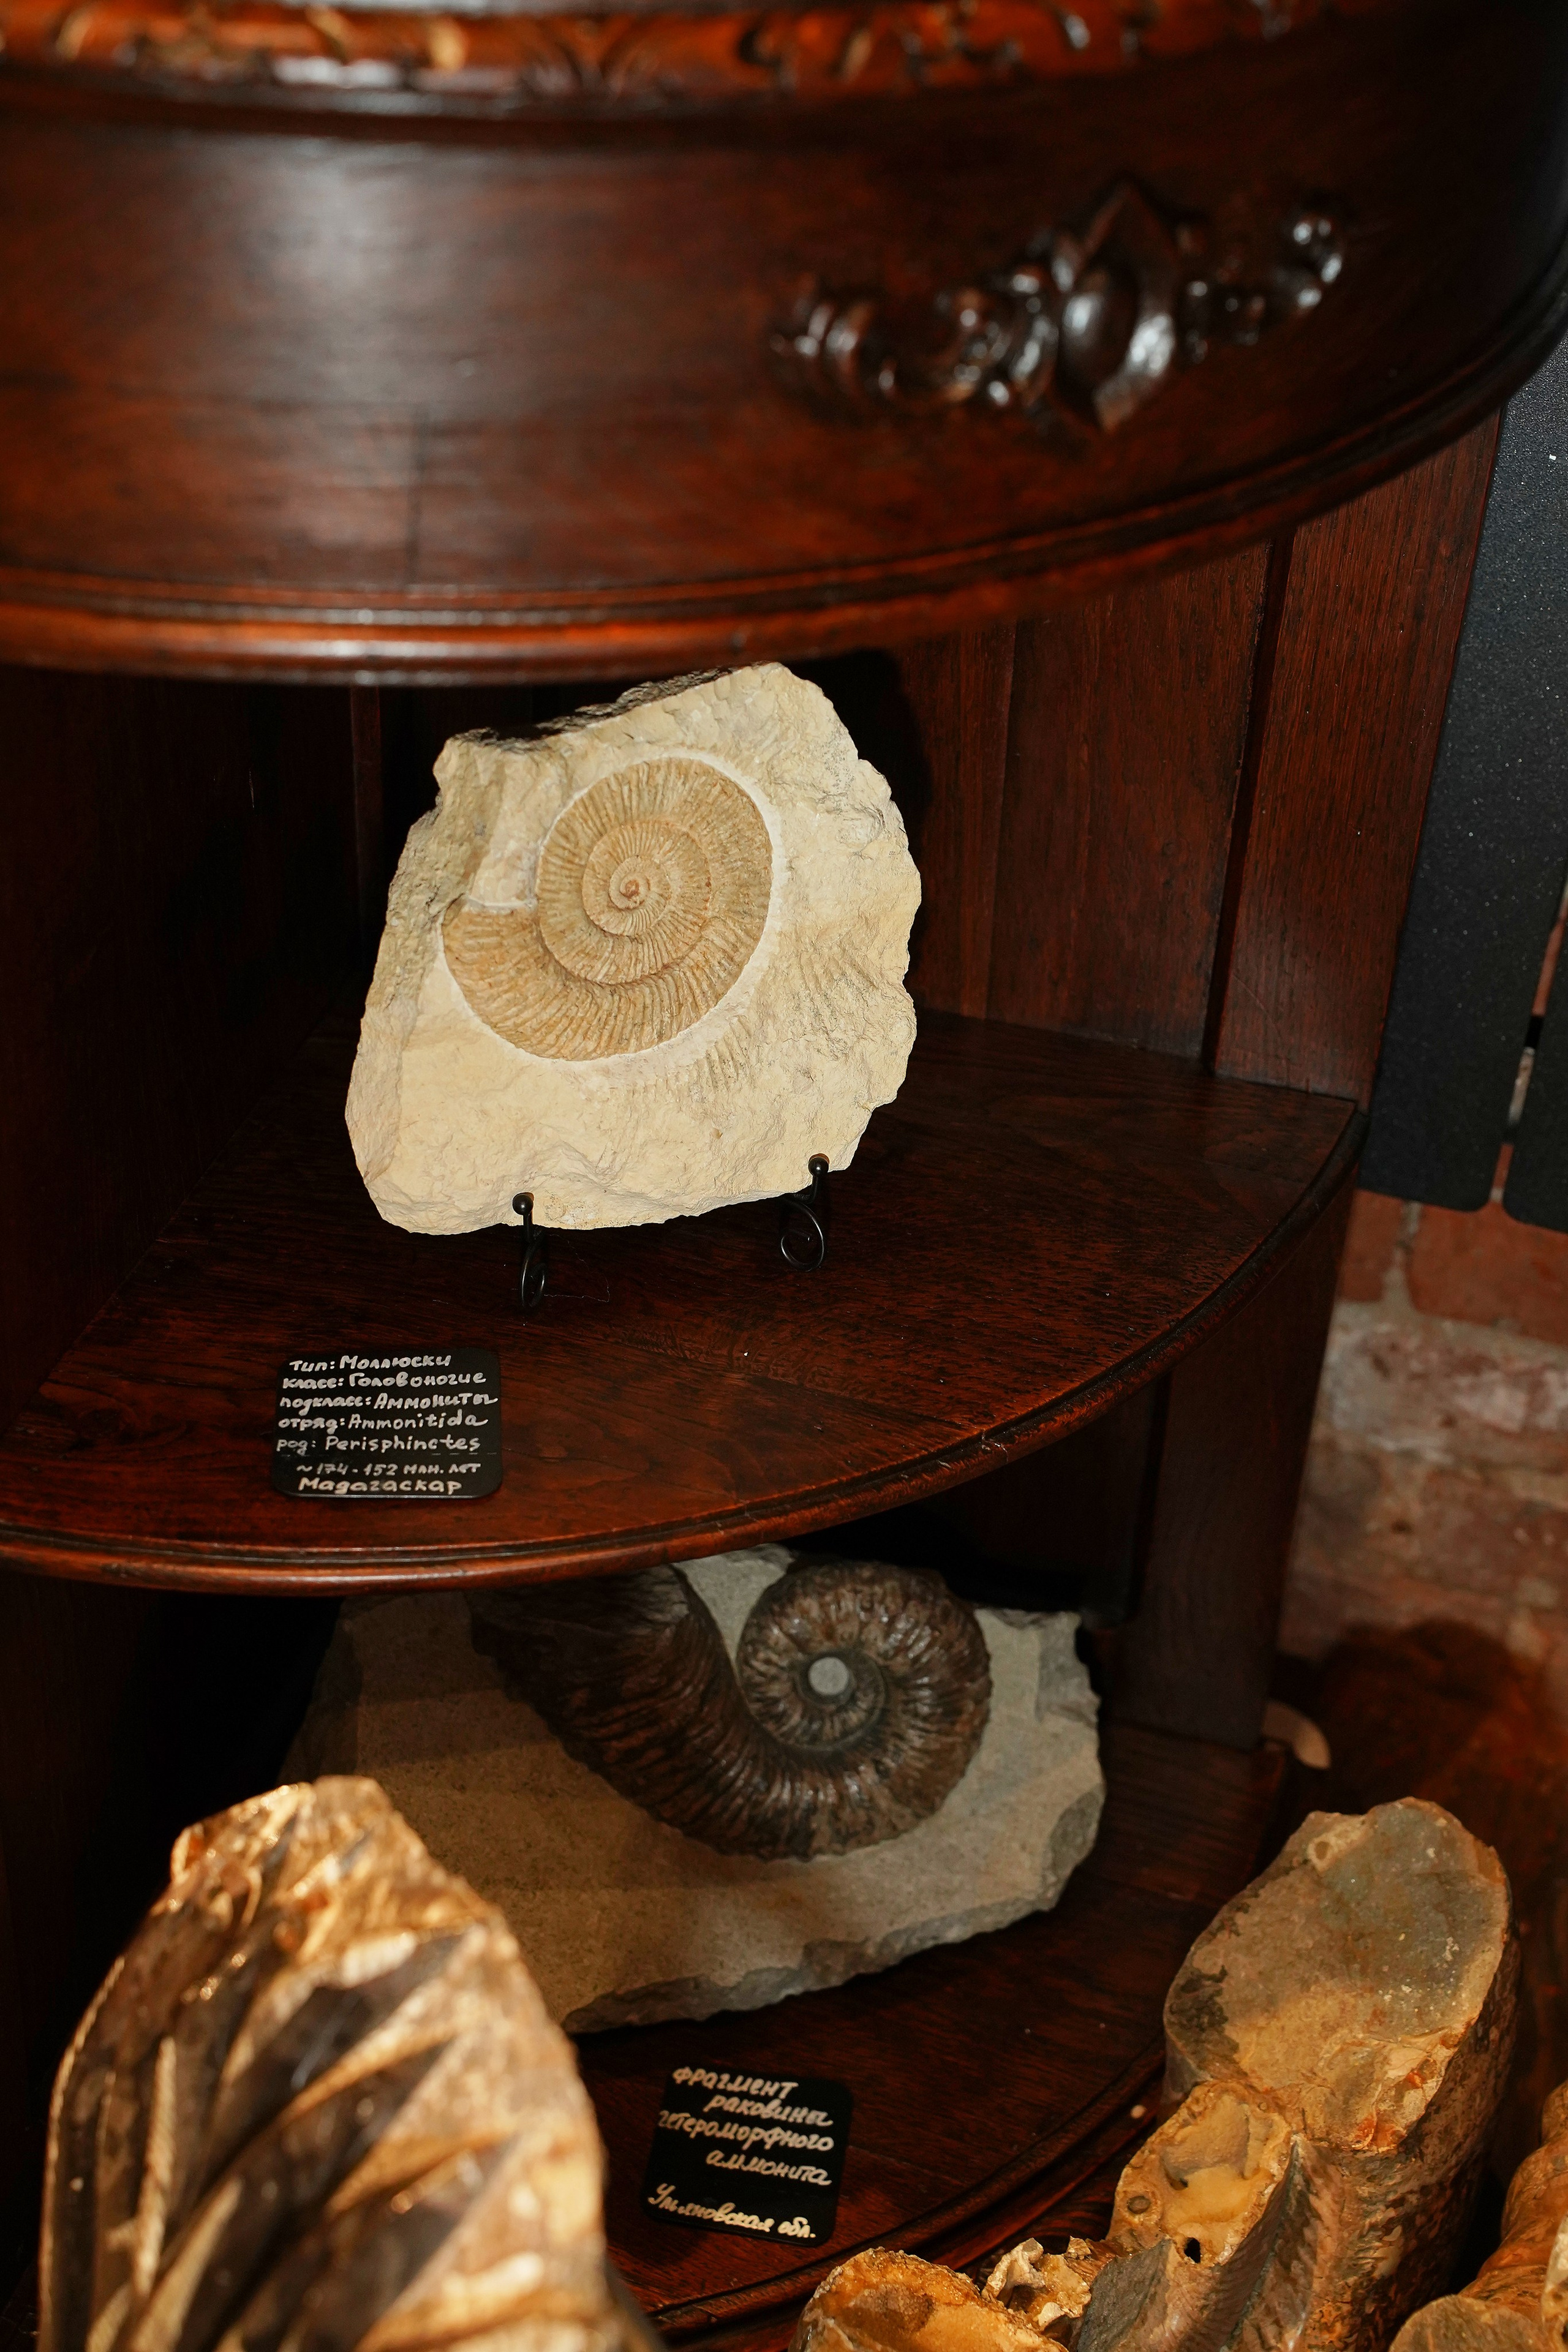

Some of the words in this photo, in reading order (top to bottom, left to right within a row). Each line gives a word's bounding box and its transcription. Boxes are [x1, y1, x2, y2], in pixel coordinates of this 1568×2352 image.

[282, 1376, 345, 1390] класс:
[349, 1371, 487, 1387] Головоногие
[279, 1395, 371, 1416] подкласс:
[374, 1392, 499, 1409] Аммониты
[278, 1417, 345, 1434] отряд:
[347, 1409, 489, 1430] Ammonitida
[276, 1438, 317, 1455] род:
[325, 1434, 481, 1453] Perisphinctes
[298, 1477, 462, 1495] Мадагаскар
[703, 2095, 834, 2127] раковины
[658, 2110, 835, 2151] гетероморфного
[706, 2150, 832, 2186] аммонита
[777, 2217, 816, 2238] обл.
